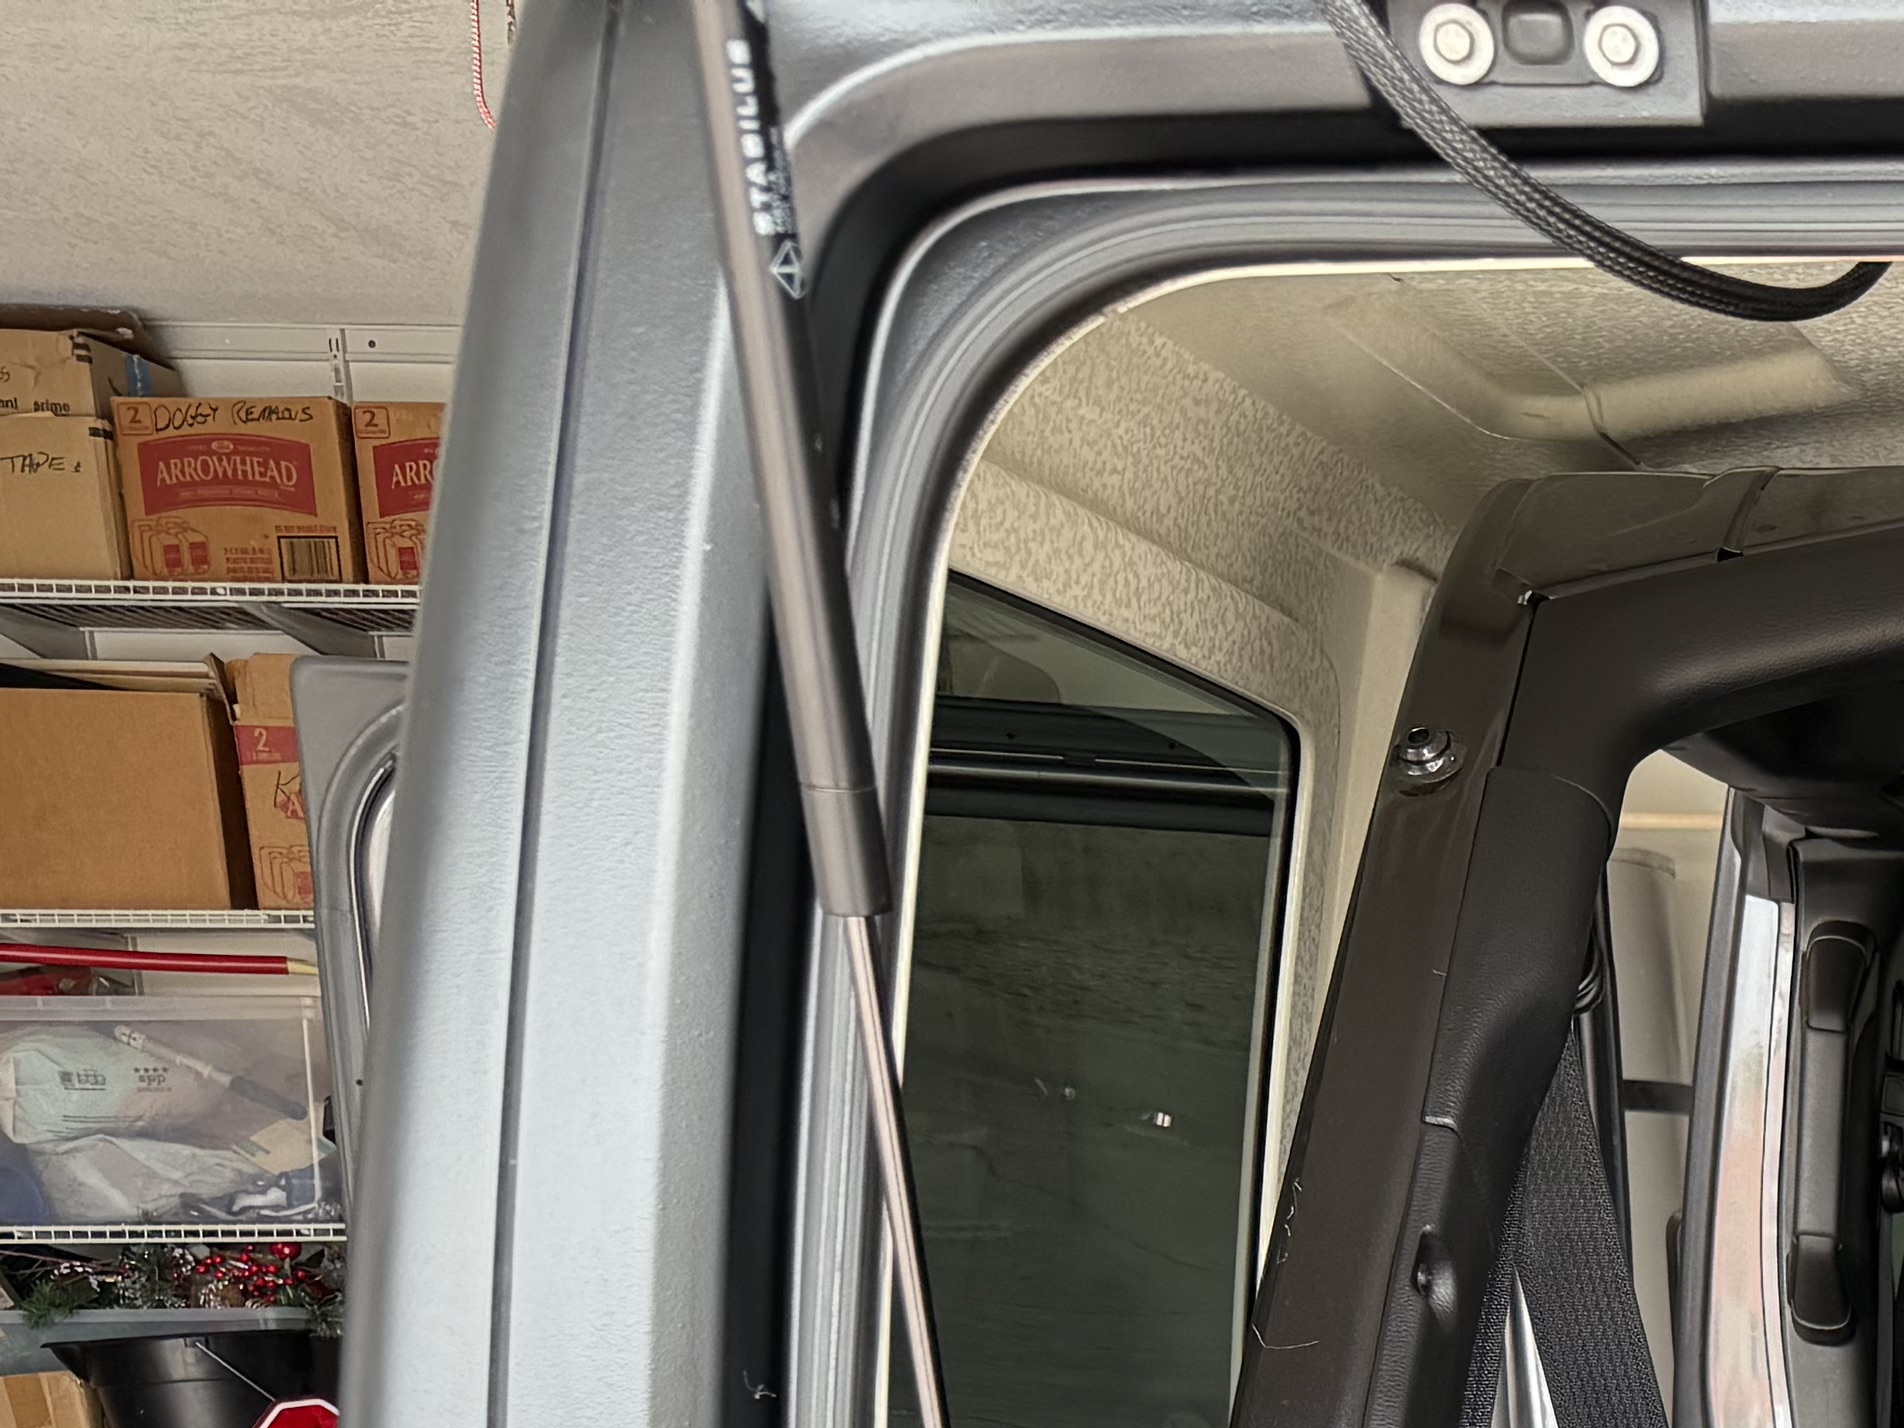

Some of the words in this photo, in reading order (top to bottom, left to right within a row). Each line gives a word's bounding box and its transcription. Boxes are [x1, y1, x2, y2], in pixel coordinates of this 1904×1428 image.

[727, 38, 776, 236] STABILUS
[126, 406, 142, 424] 2
[363, 410, 379, 428] 2
[156, 455, 298, 490] ARROWHEAD
[391, 459, 436, 490] ARR
[254, 727, 270, 751] 2
